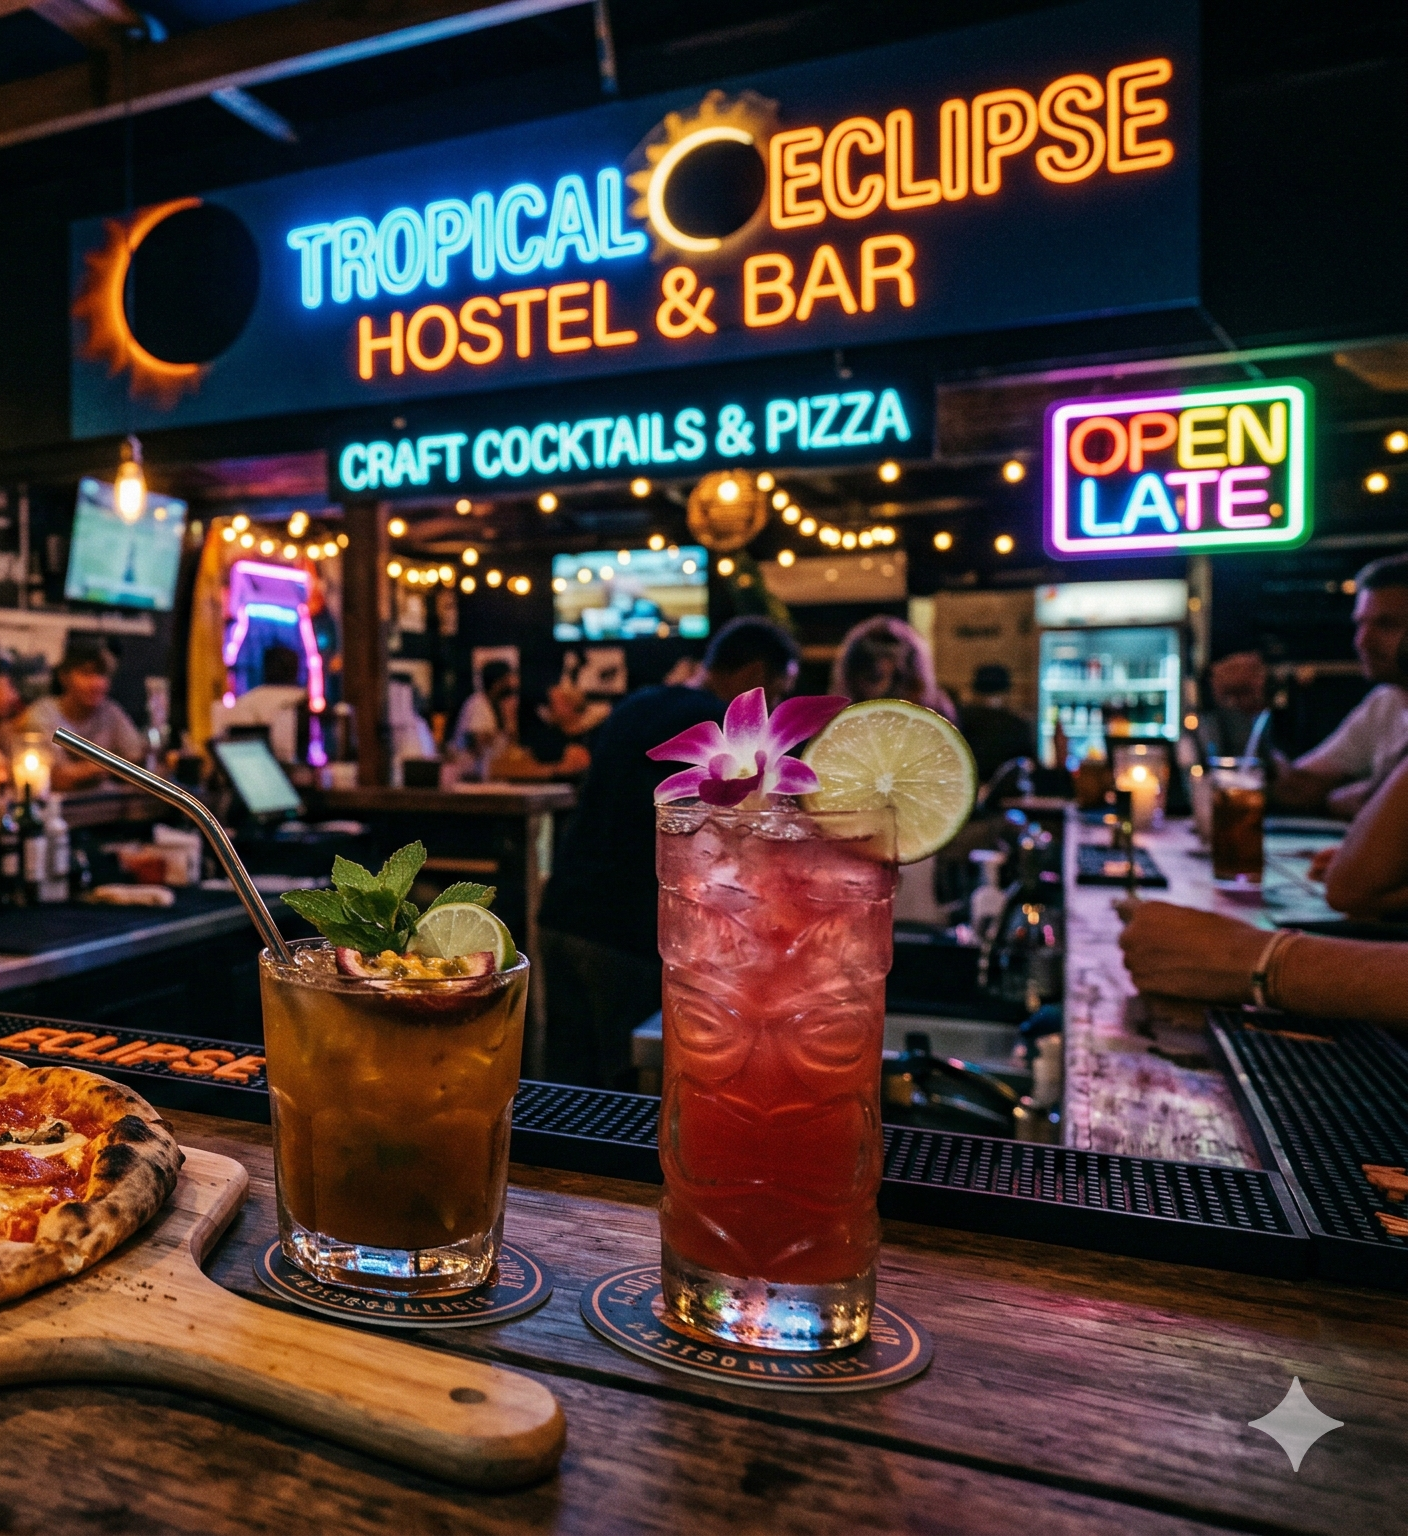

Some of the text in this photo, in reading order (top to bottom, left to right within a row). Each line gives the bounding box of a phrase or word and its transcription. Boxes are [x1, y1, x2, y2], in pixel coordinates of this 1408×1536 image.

[287, 57, 1174, 309] TROPICAL ECLIPSE
[357, 234, 917, 381] HOSTEL & BAR
[339, 387, 912, 491] CRAFT COCKTAILS & PIZZA
[1068, 400, 1288, 478] OPEN
